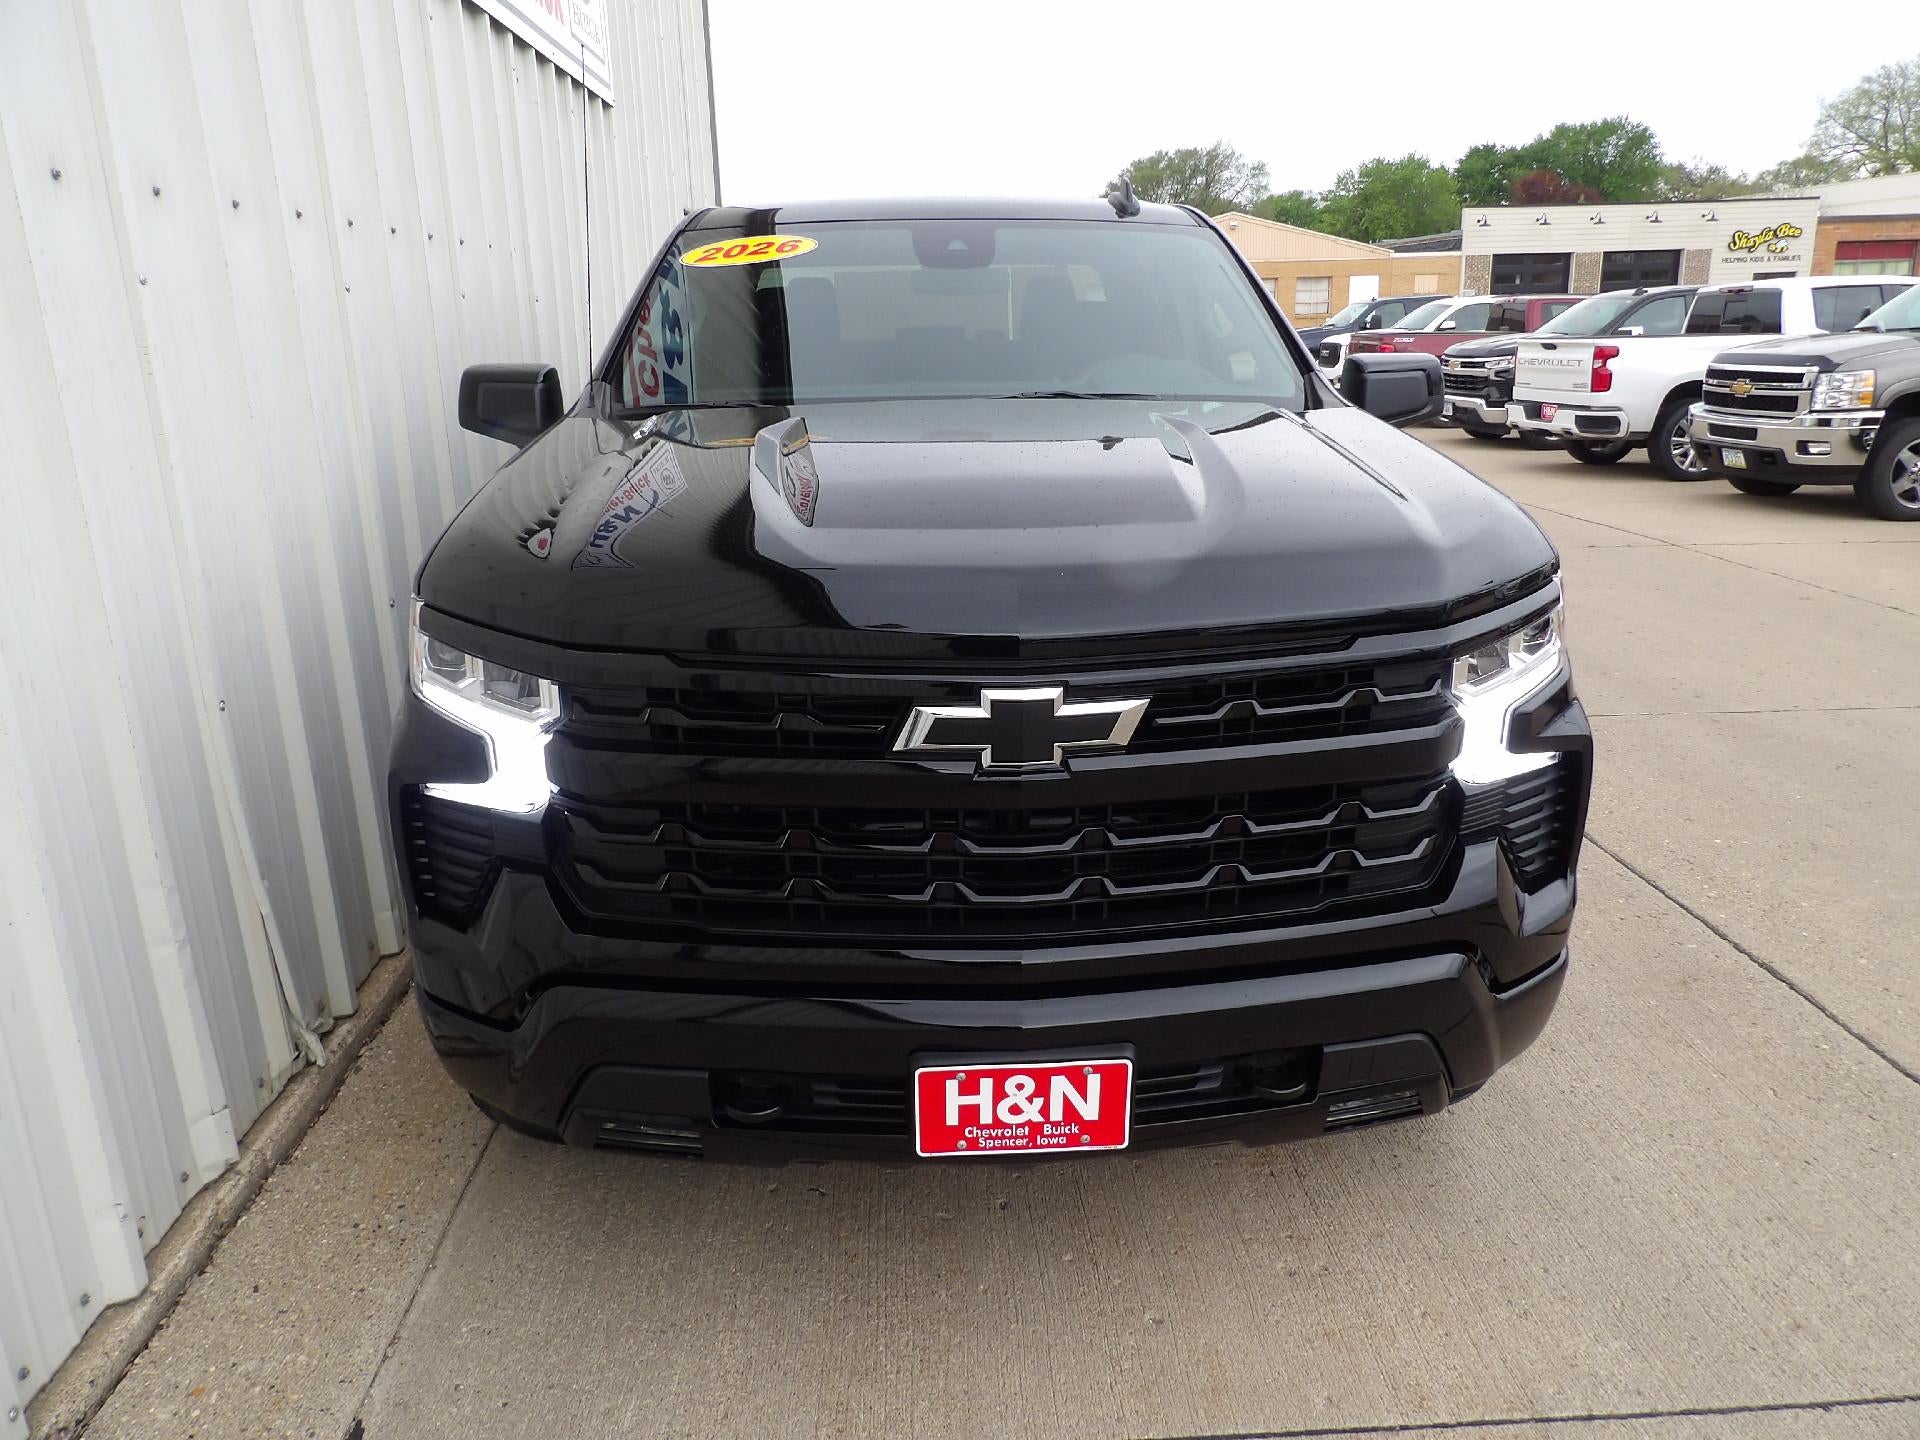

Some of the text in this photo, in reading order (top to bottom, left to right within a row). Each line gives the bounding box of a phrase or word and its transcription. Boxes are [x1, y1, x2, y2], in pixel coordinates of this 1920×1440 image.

[1729, 223, 1802, 253] Shayla Bee
[694, 239, 804, 263] 2026
[1722, 256, 1748, 264] HELPING
[1517, 357, 1584, 368] CHEVROLET
[945, 1073, 1101, 1126] H&N
[964, 1122, 1080, 1138] Chevrolet Buick
[978, 1134, 1067, 1148] Spencer, Iowa
